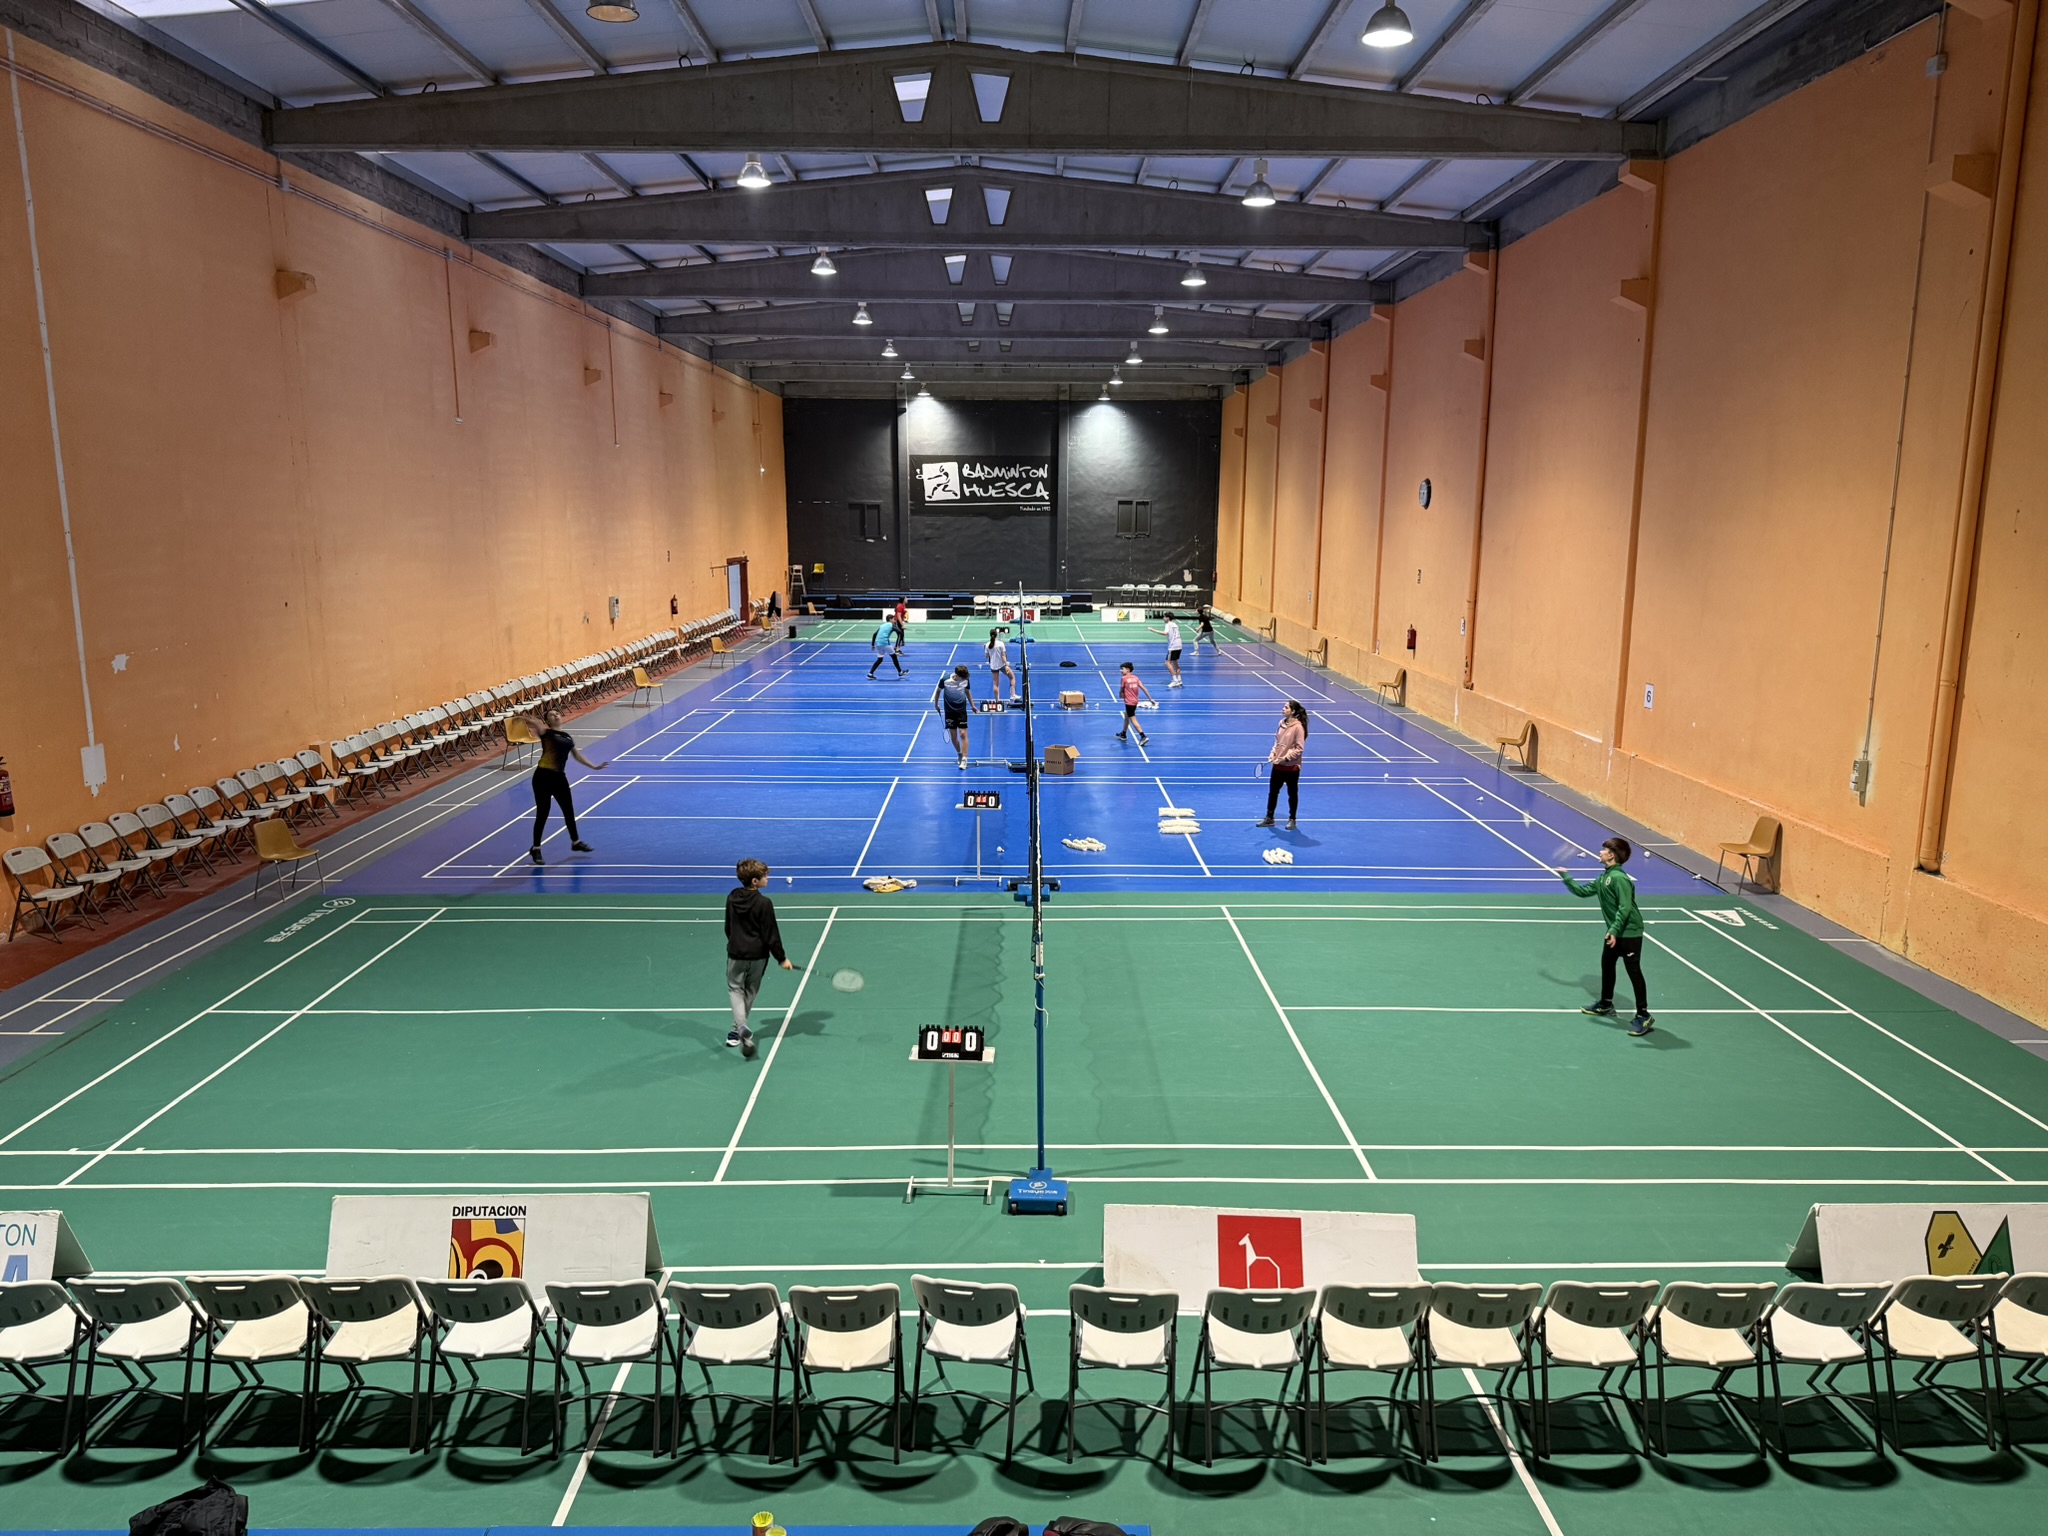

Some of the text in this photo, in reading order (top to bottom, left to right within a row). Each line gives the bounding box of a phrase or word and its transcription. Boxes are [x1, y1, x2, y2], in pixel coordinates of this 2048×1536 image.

[962, 481, 1049, 500] HUESCA
[1646, 690, 1652, 703] 6
[967, 795, 975, 807] 0
[988, 795, 996, 807] 0
[926, 1030, 977, 1052] 0 0 0 0
[452, 1205, 527, 1217] DIPUTACION
